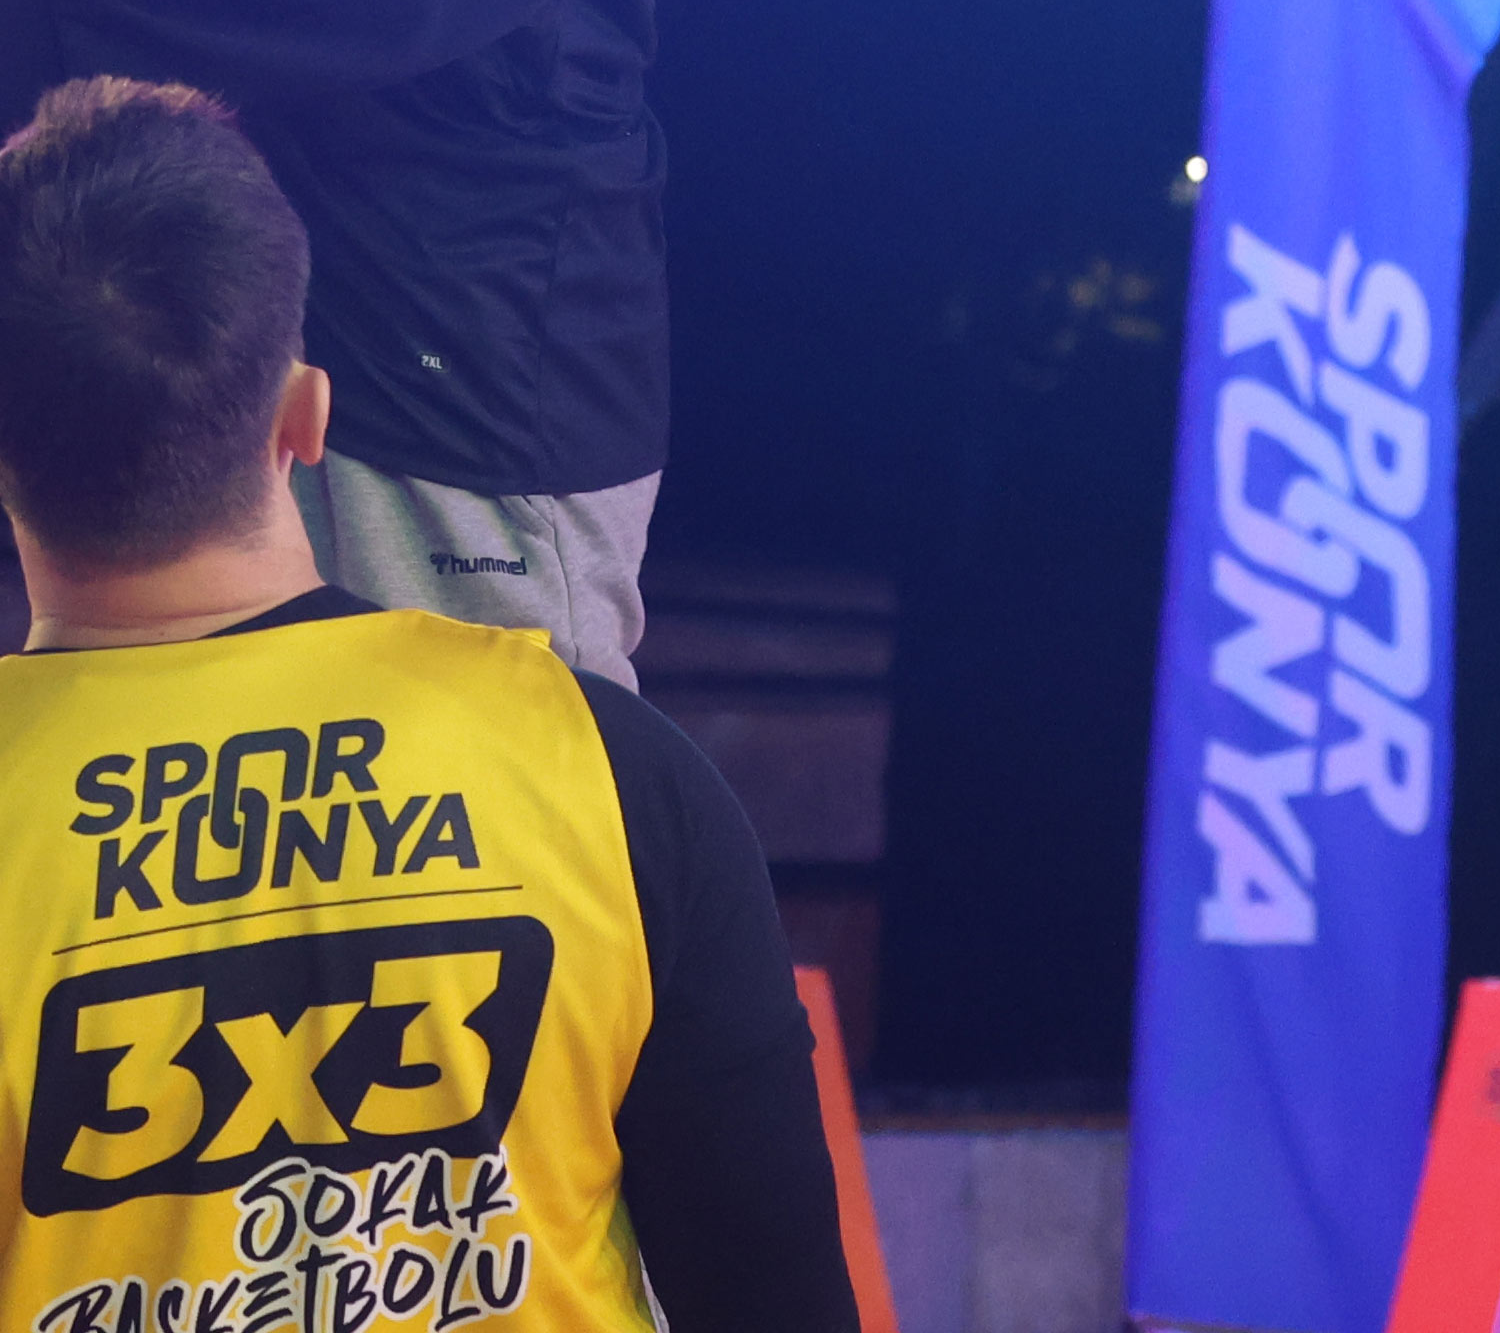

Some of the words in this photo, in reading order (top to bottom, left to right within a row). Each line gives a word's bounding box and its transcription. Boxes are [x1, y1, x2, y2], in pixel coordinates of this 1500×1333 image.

[420, 354, 443, 370] 2XL
[450, 543, 528, 576] hummel
[1198, 221, 1360, 945] KONYA
[1279, 229, 1432, 835] SPOR
[68, 717, 386, 850] SPOR
[93, 786, 482, 921] KONYA
[60, 949, 503, 1182] 3x3
[238, 1151, 514, 1263] SOKAK
[36, 1238, 527, 1333] BASKETBOLU
